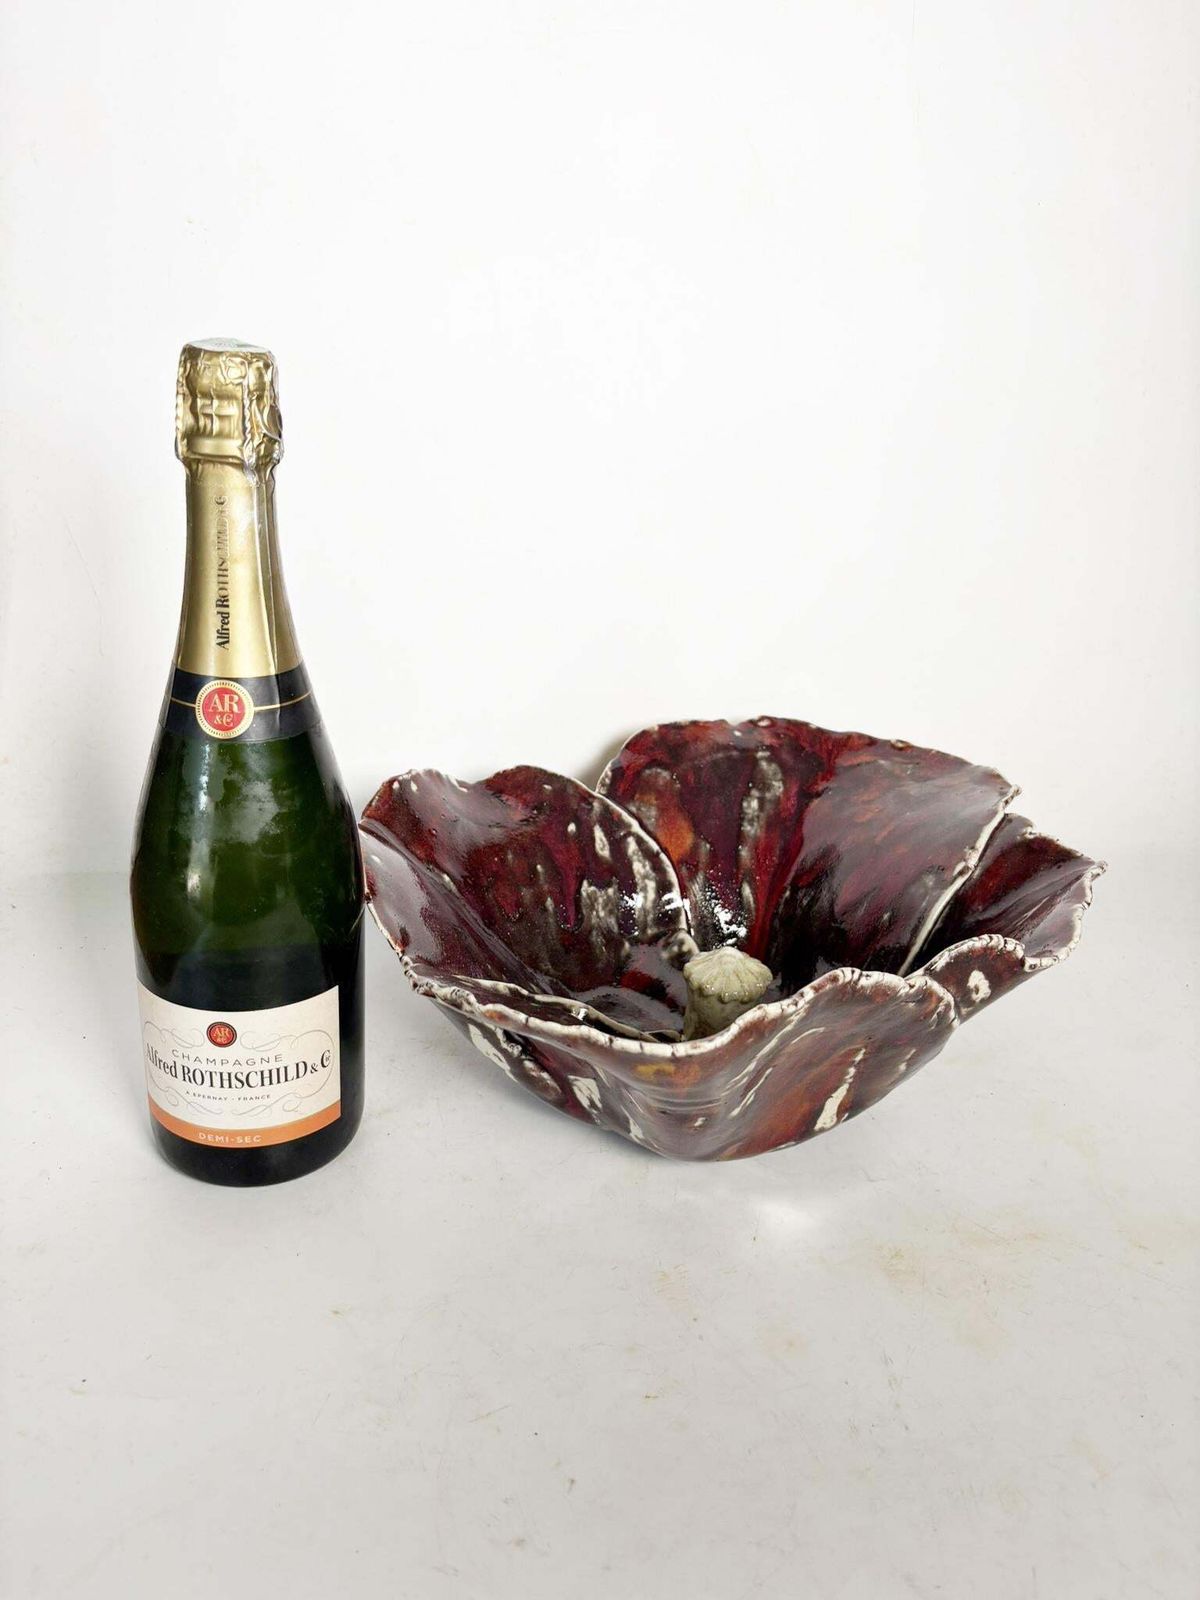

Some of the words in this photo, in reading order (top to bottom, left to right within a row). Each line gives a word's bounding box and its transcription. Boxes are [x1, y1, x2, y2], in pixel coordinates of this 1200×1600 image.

[216, 611, 230, 650] Alfred
[208, 693, 241, 714] AR
[146, 1043, 178, 1079] Alfred
[181, 1060, 308, 1089] ROTHSCHILD
[172, 1049, 283, 1067] CHAMPAGNE
[198, 1132, 262, 1144] DEMI-SEC
